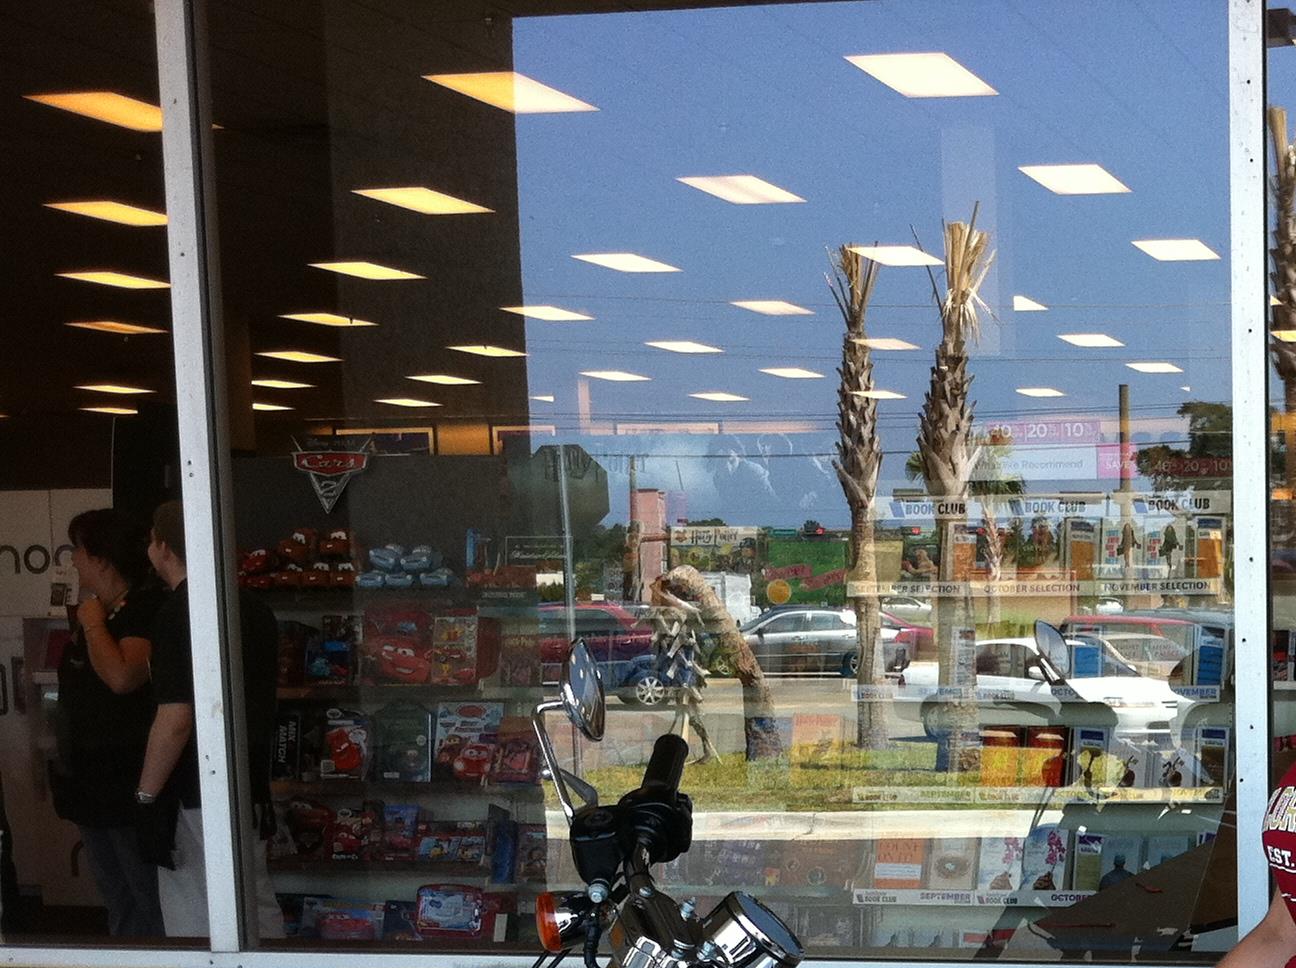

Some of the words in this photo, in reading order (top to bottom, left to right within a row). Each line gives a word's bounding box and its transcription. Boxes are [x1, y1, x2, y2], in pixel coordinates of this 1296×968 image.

[904, 502, 934, 516] BOOK
[937, 502, 966, 515] CLUB
[1025, 501, 1054, 514] BOOK
[1057, 500, 1086, 513] CLUB
[1148, 499, 1178, 512] BOOK
[1180, 497, 1211, 510] CLUB
[910, 584, 961, 594] SELECTION
[983, 584, 1026, 594] OCTOBER
[1028, 583, 1081, 594] SELECTION
[1103, 582, 1158, 593] NOVEMBER
[1160, 580, 1211, 592] SELECTION
[1174, 687, 1217, 696] OVEMBER
[1266, 846, 1295, 868] EST.
[920, 892, 971, 900] SEPTEMBER
